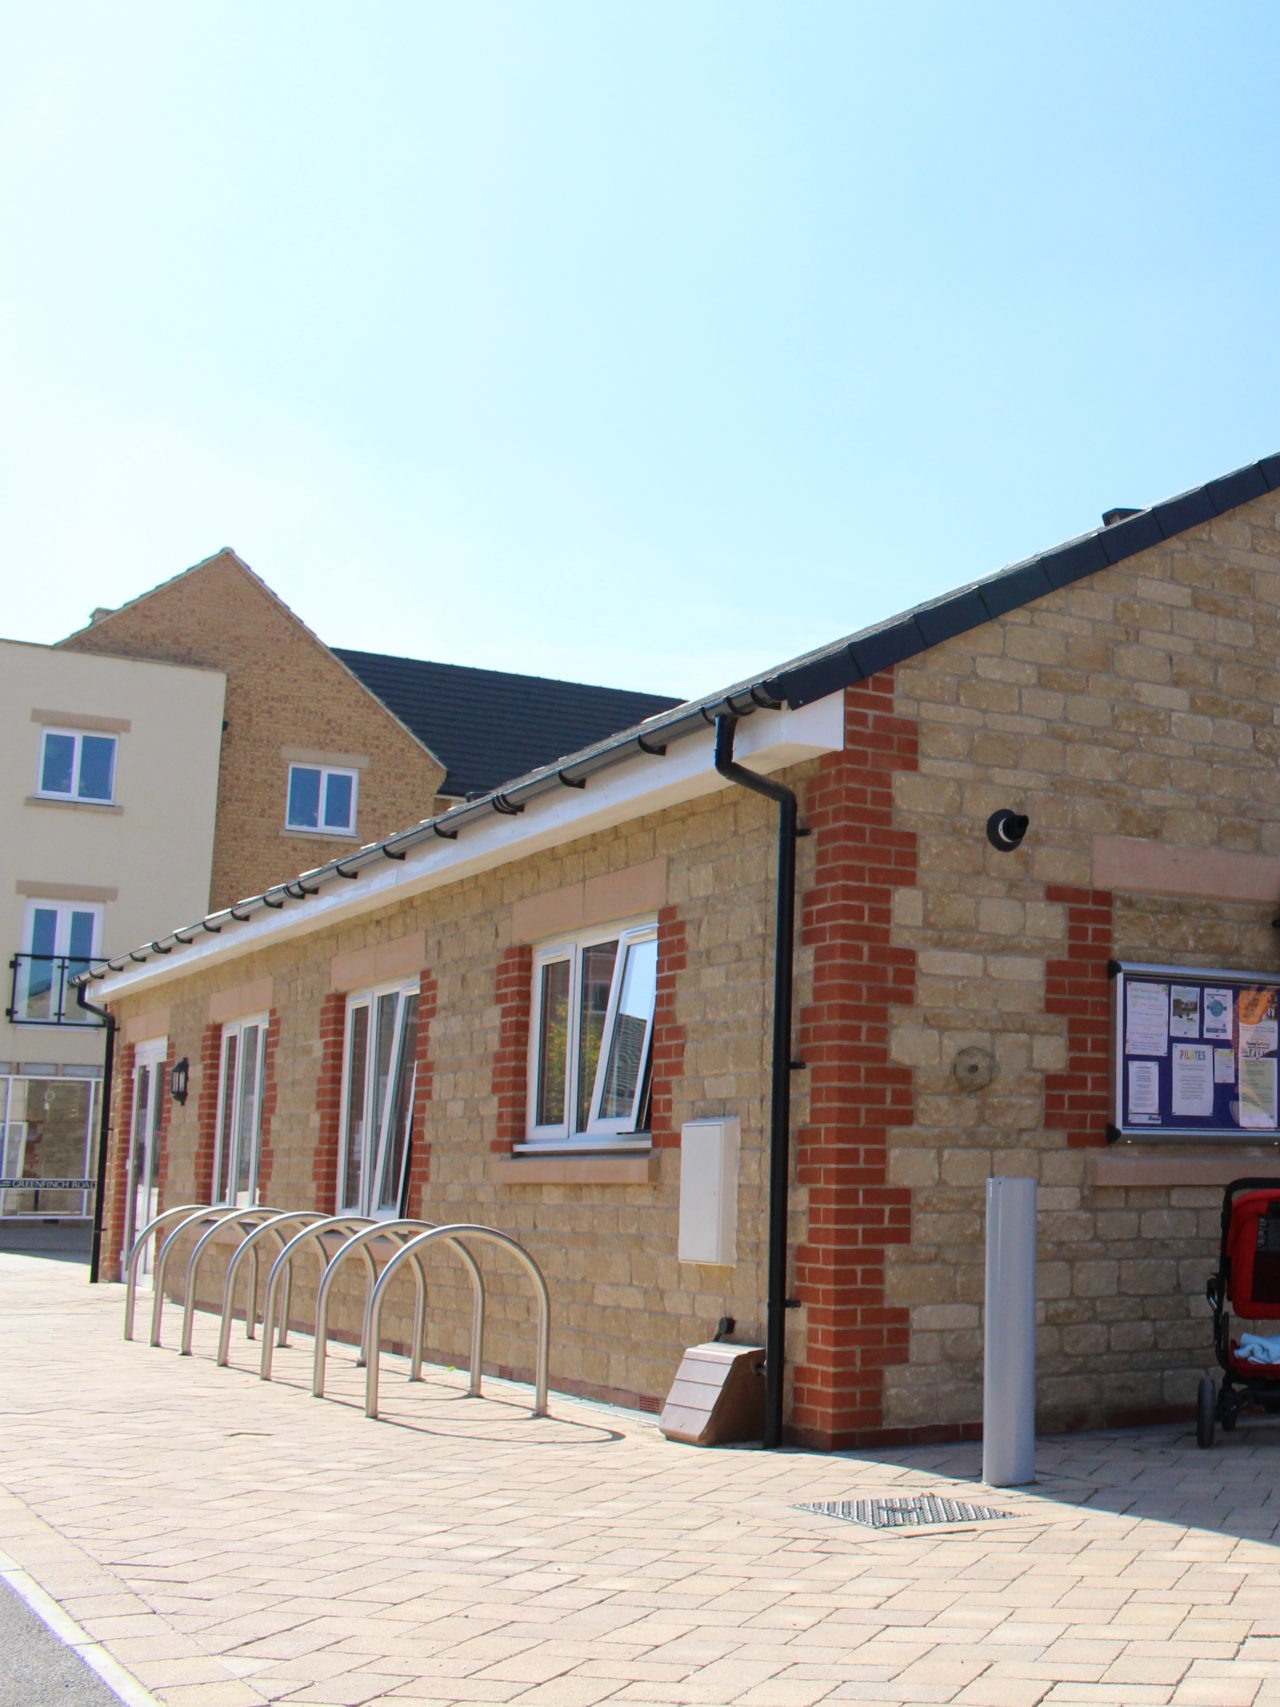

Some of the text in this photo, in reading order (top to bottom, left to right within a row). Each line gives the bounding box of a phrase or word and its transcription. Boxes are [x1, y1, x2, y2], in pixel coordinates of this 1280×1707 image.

[1179, 1049, 1206, 1061] PILATES
[12, 1180, 96, 1189] GREENFINCH ROAD
